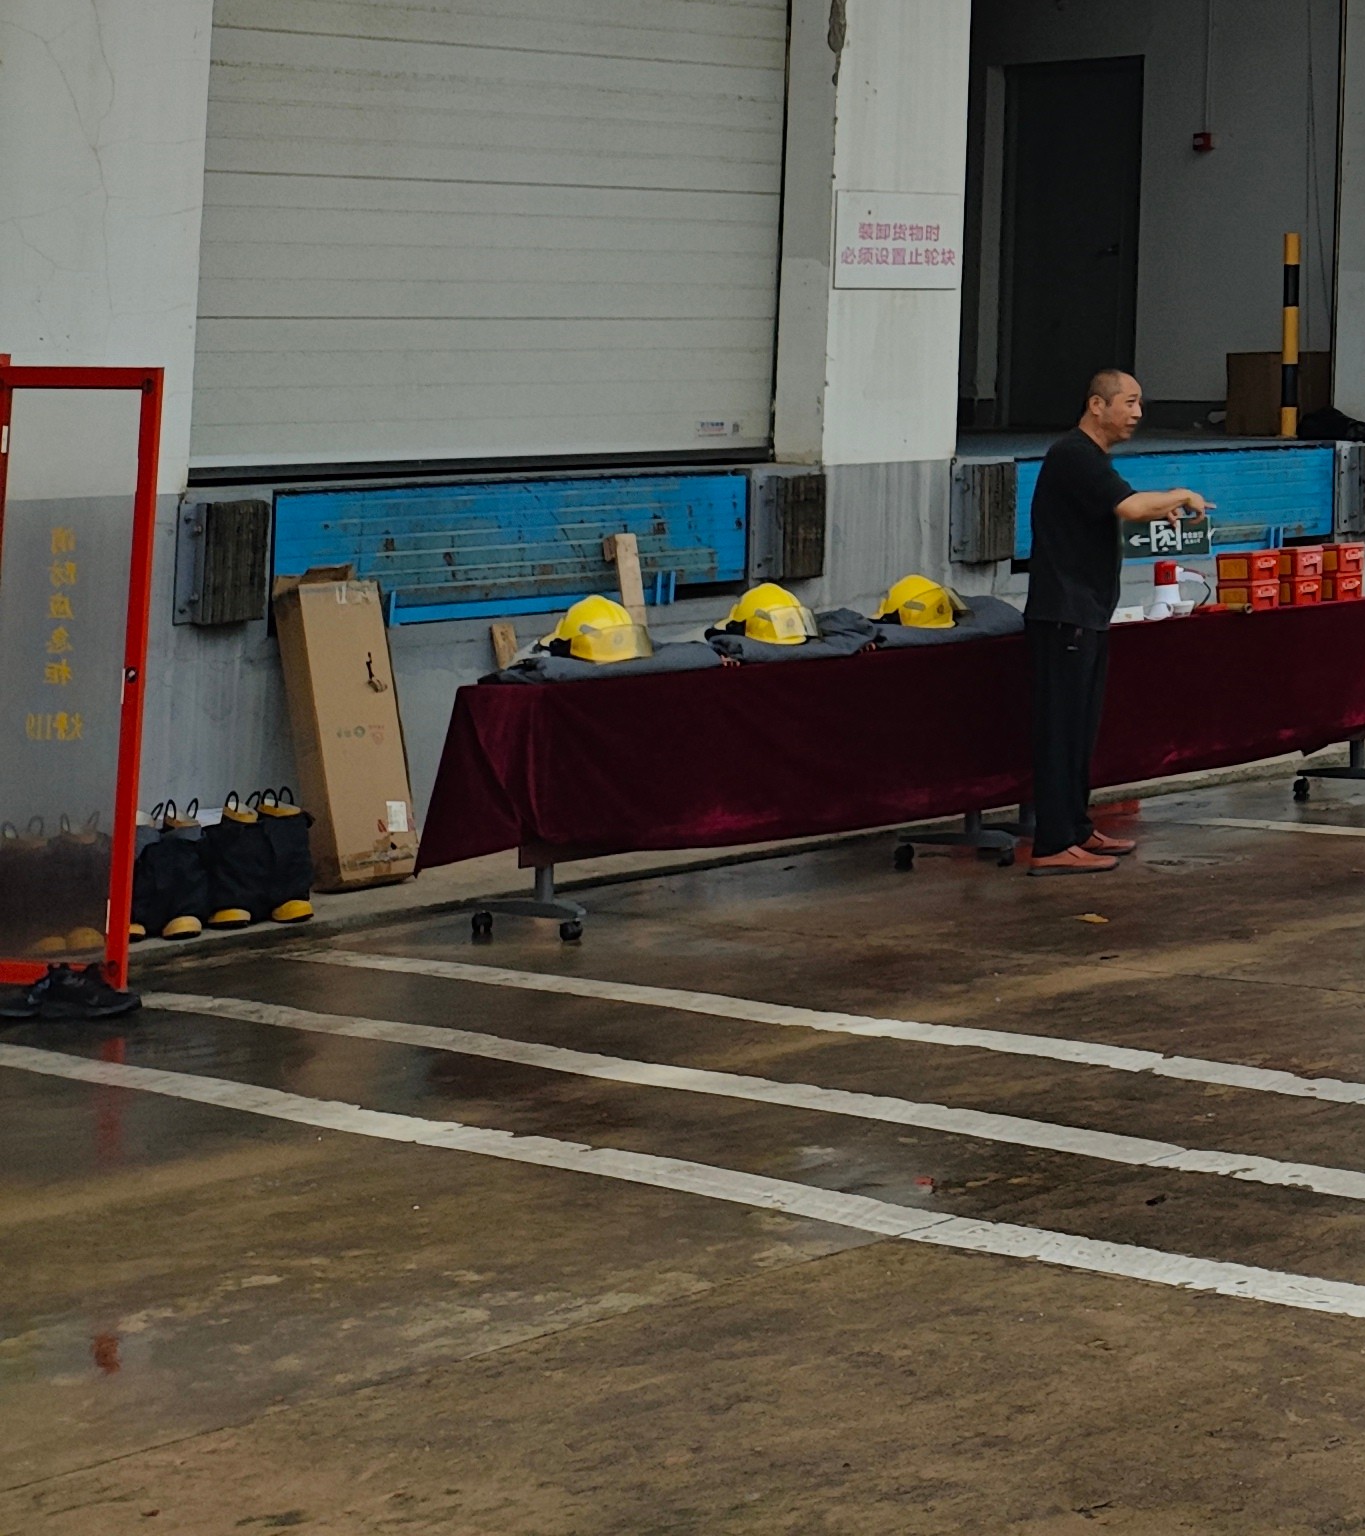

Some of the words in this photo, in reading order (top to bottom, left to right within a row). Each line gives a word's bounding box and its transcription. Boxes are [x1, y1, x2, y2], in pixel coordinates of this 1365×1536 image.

[858, 222, 940, 242] 装卸货物时
[841, 246, 956, 266] 必须设置止轮块
